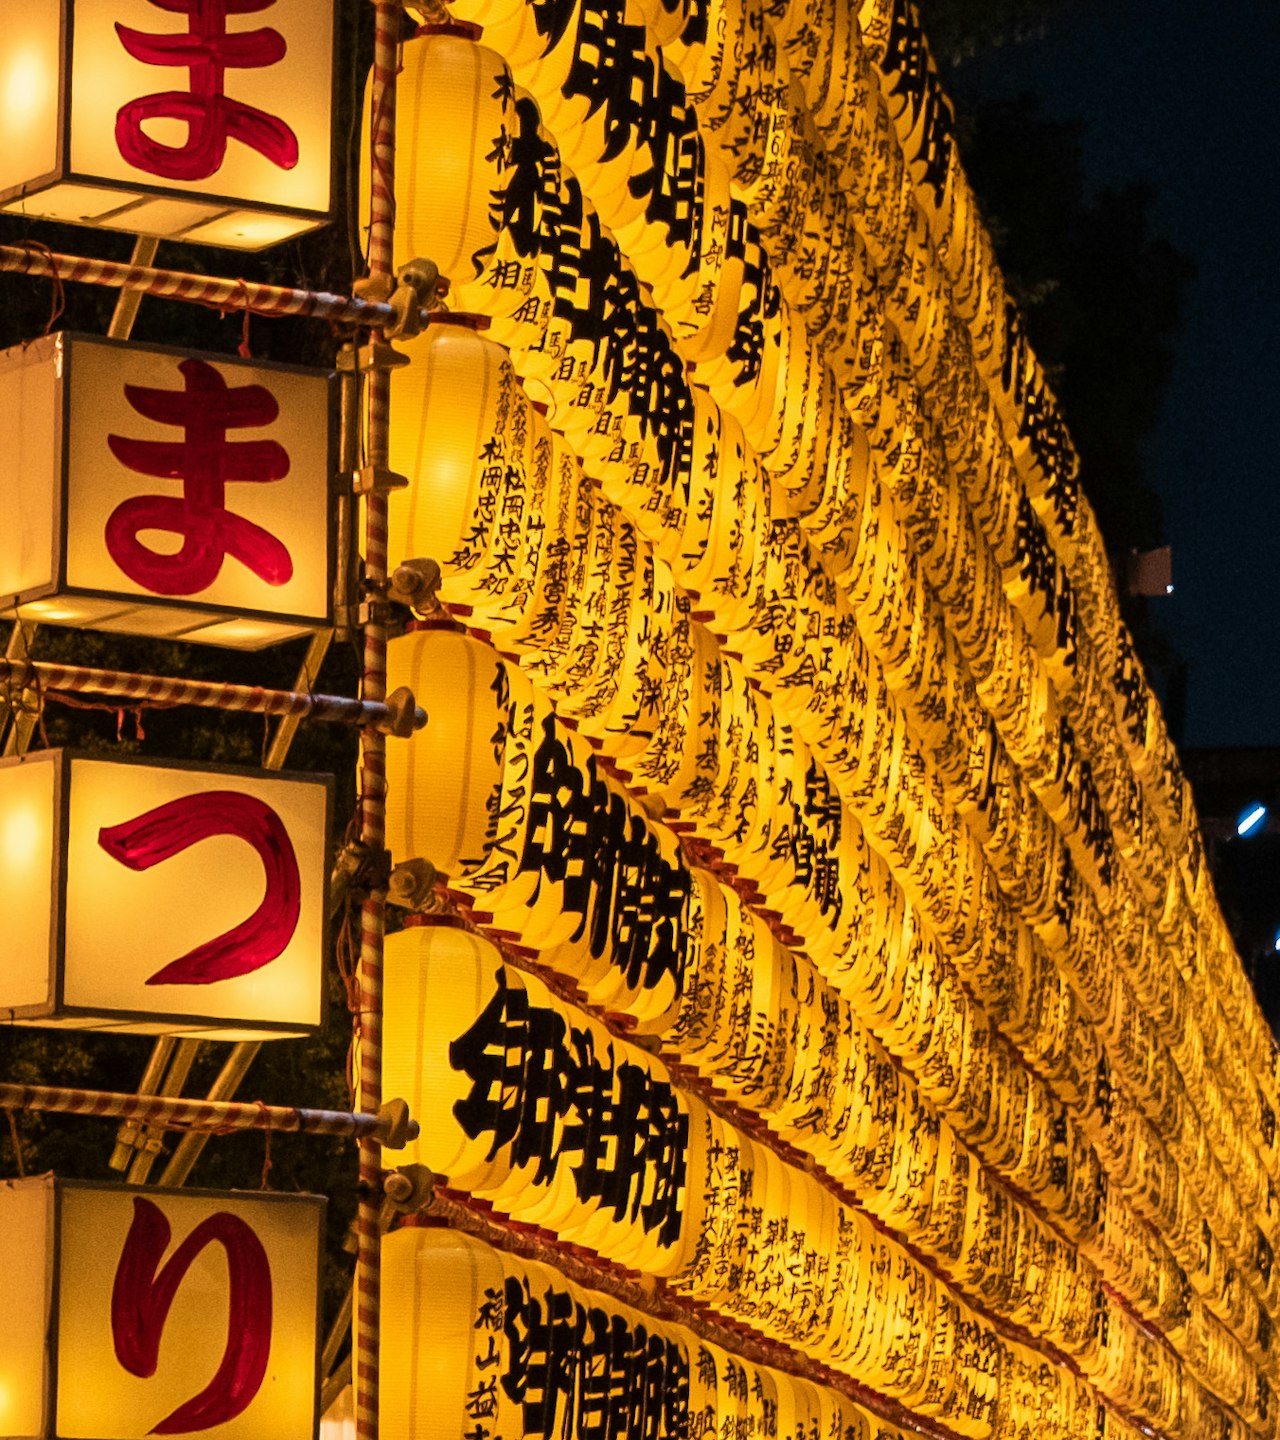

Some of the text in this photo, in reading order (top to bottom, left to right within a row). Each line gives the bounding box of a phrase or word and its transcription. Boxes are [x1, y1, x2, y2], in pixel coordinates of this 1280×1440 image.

[104, 360, 293, 594] ま
[98, 791, 301, 984] つ
[112, 1195, 273, 1434] り
